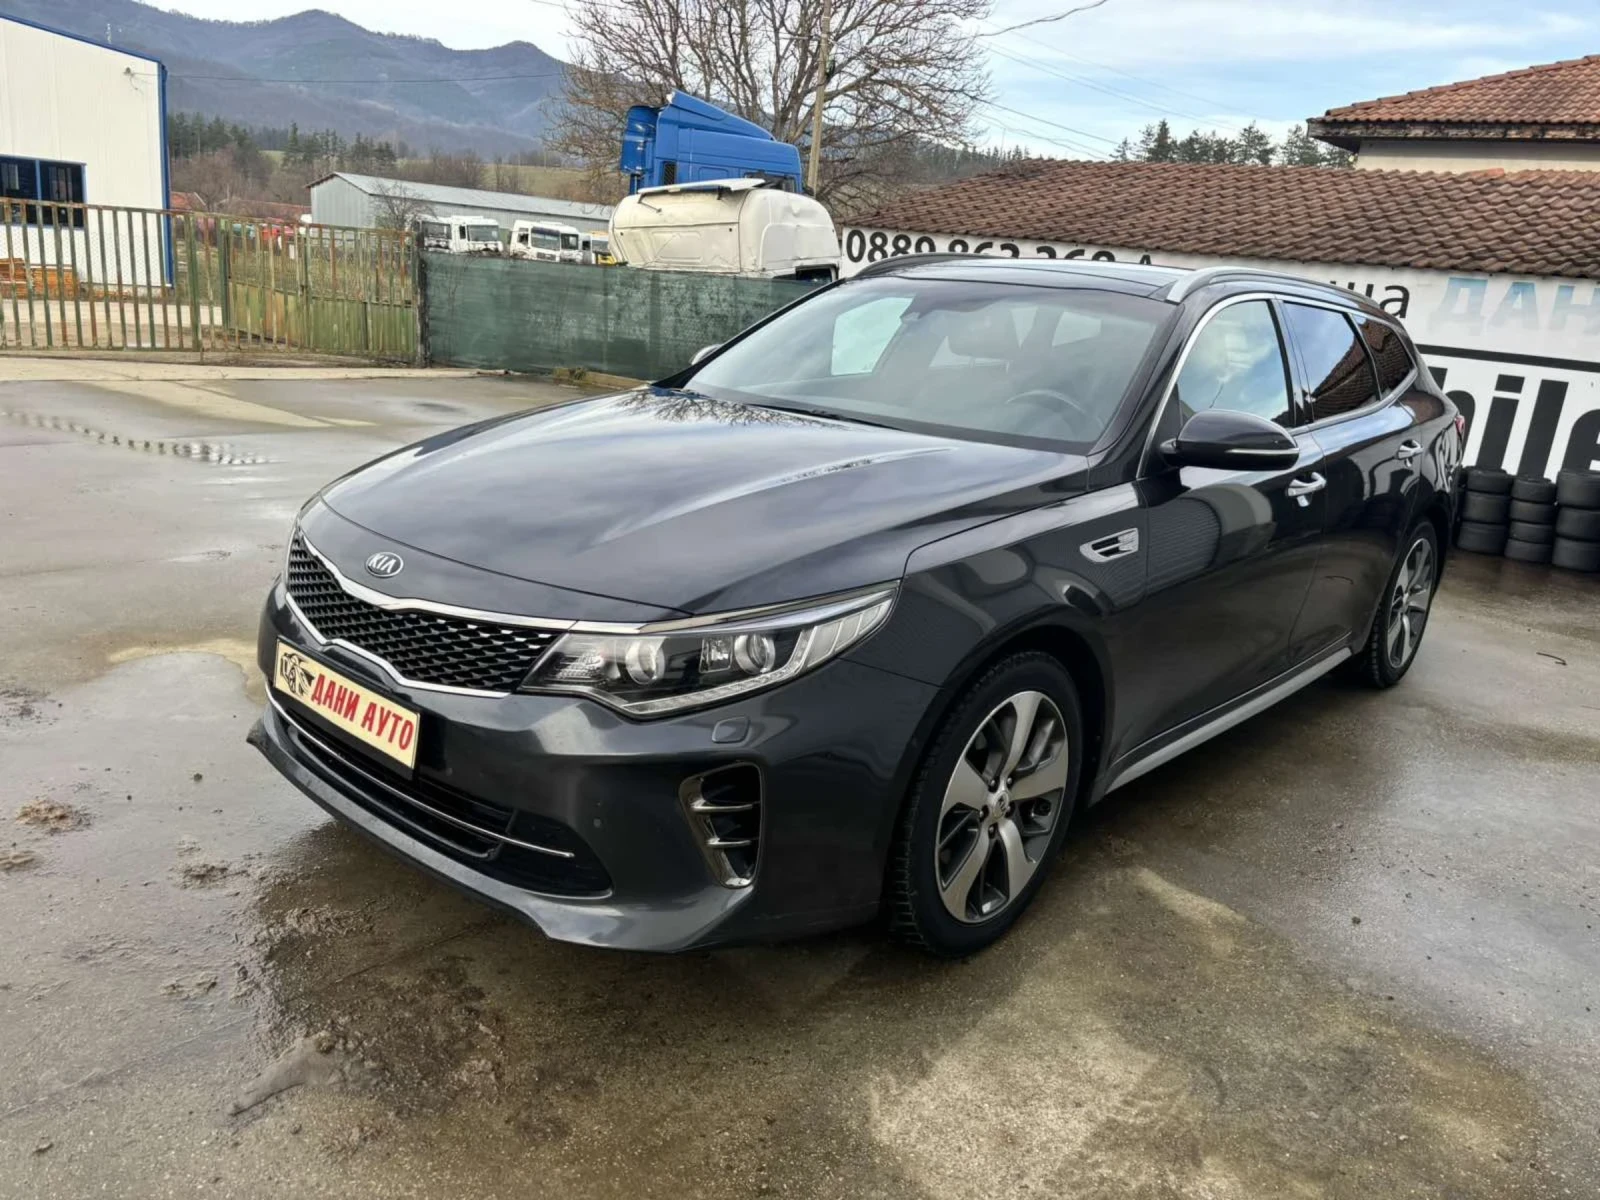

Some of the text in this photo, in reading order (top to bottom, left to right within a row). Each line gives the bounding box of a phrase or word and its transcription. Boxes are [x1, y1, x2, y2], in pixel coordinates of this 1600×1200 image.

[368, 553, 397, 574] KIA
[310, 673, 415, 751] ДАНИ АУТО
